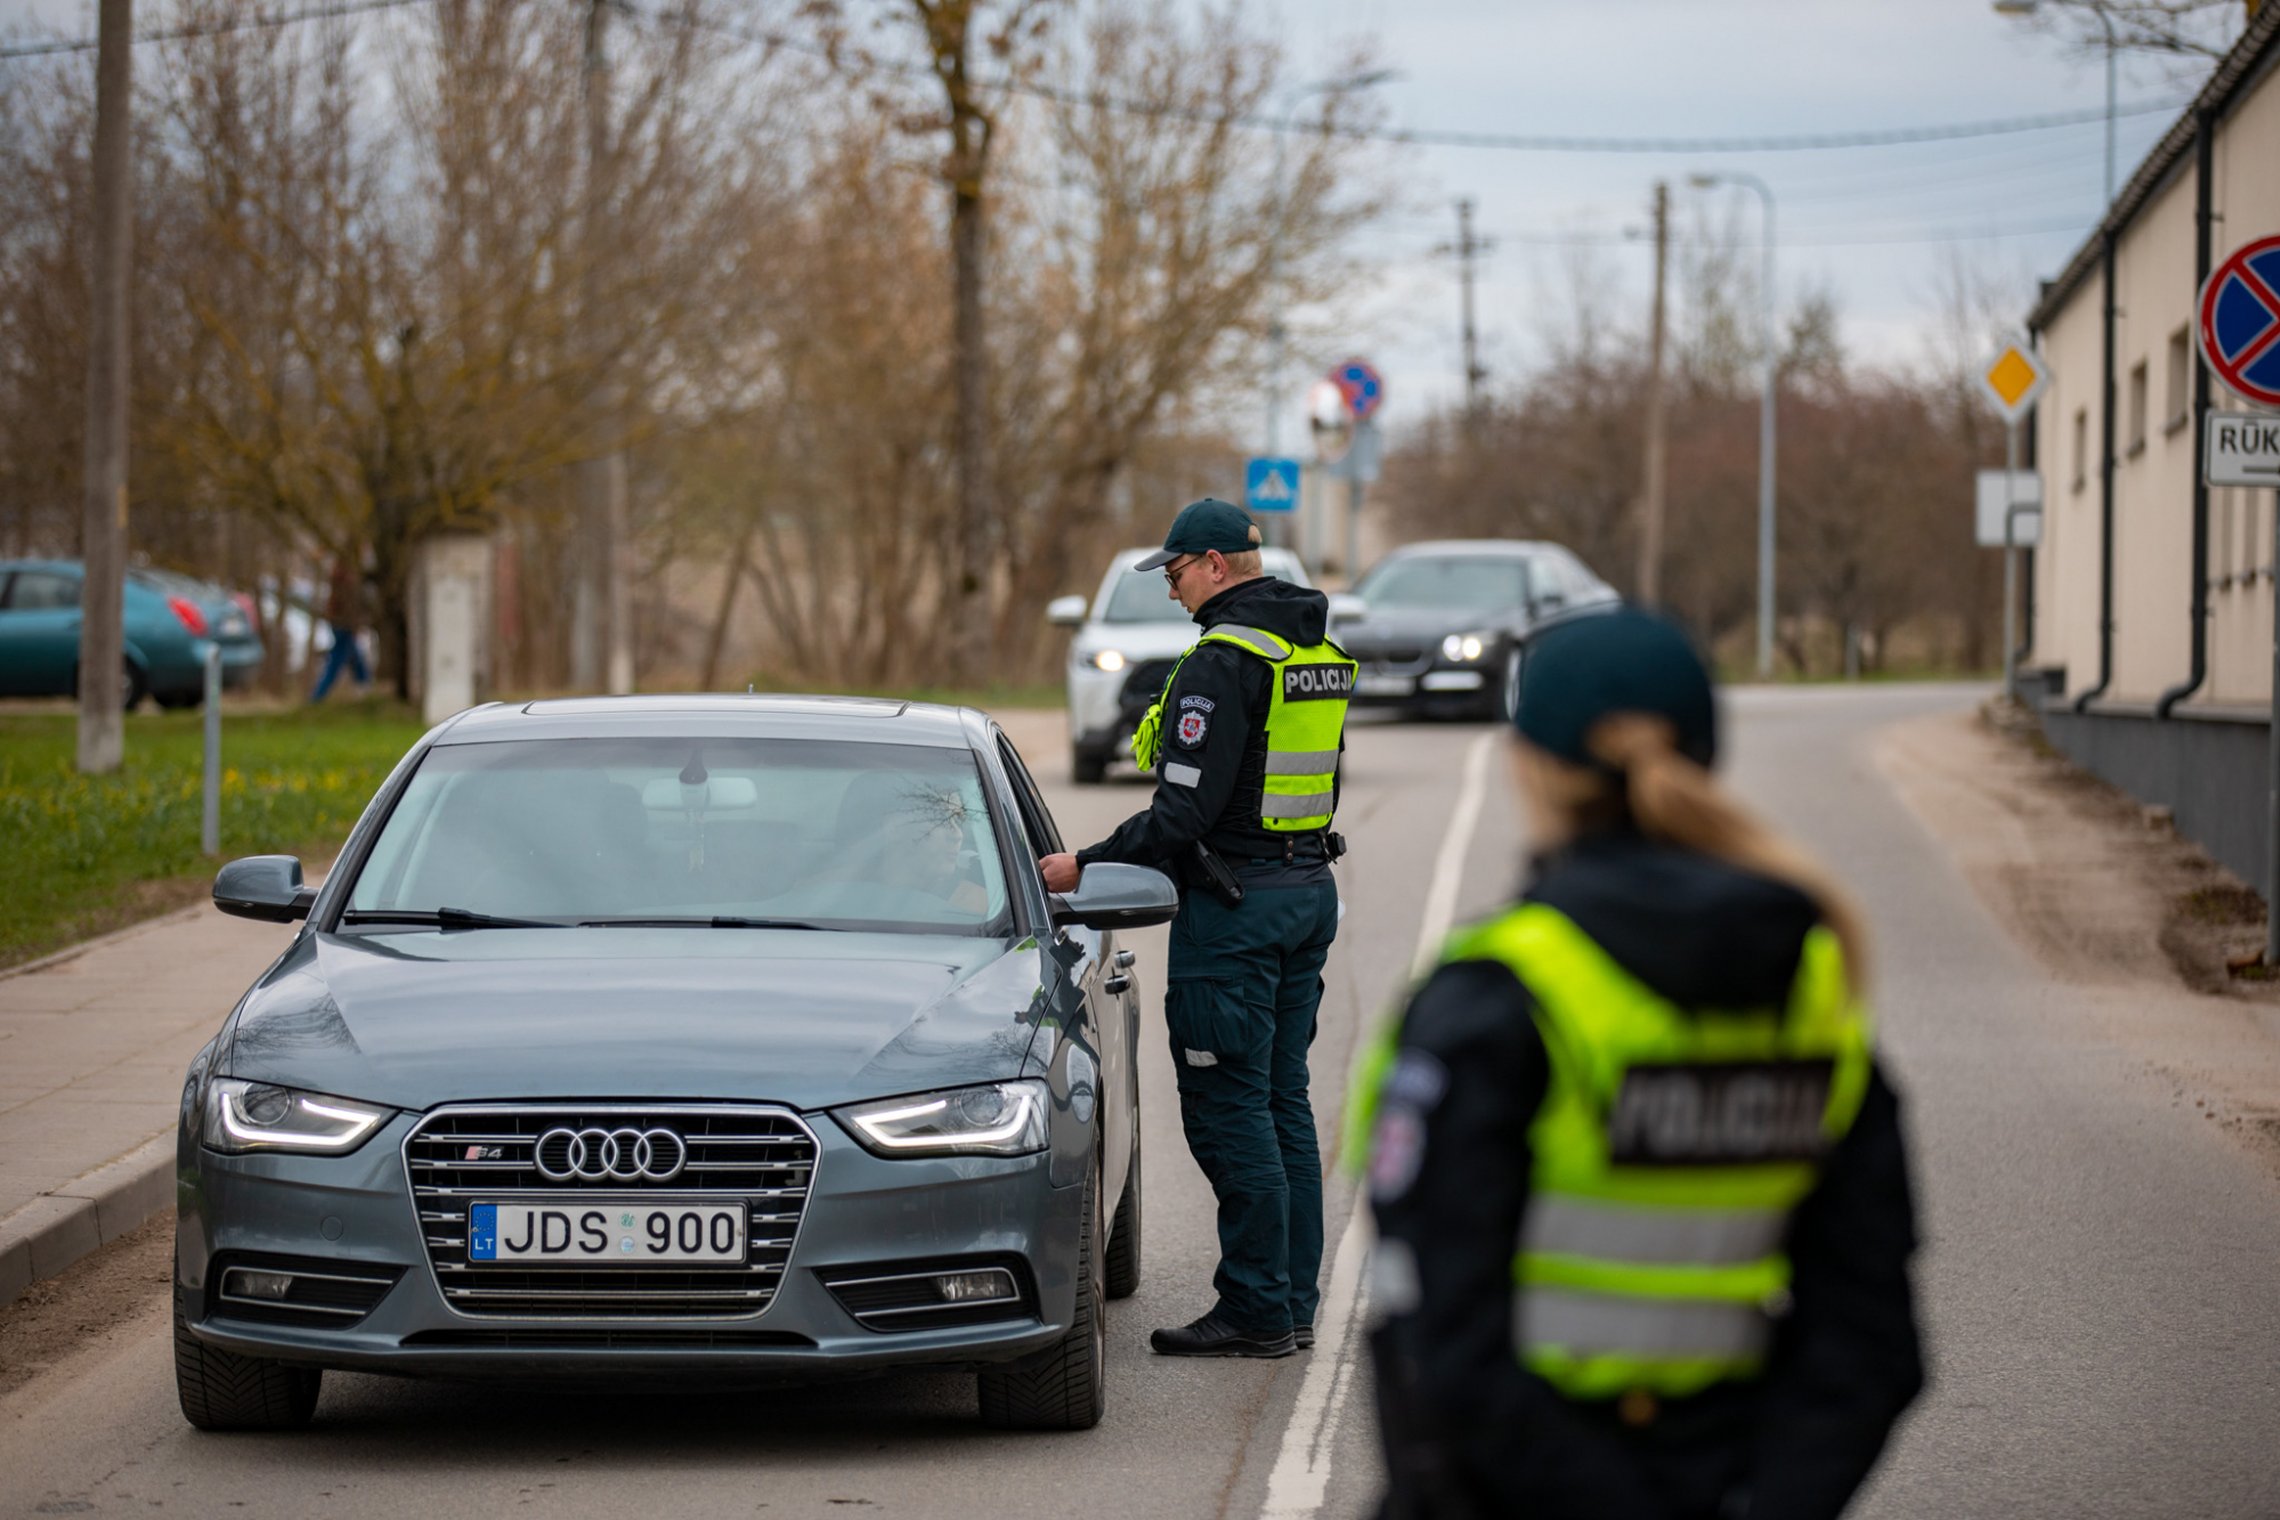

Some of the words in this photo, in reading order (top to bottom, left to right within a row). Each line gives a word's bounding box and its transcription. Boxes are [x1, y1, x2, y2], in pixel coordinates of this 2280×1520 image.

[474, 1238, 494, 1250] LT
[504, 1211, 608, 1254] JDS
[646, 1211, 735, 1254] 900
